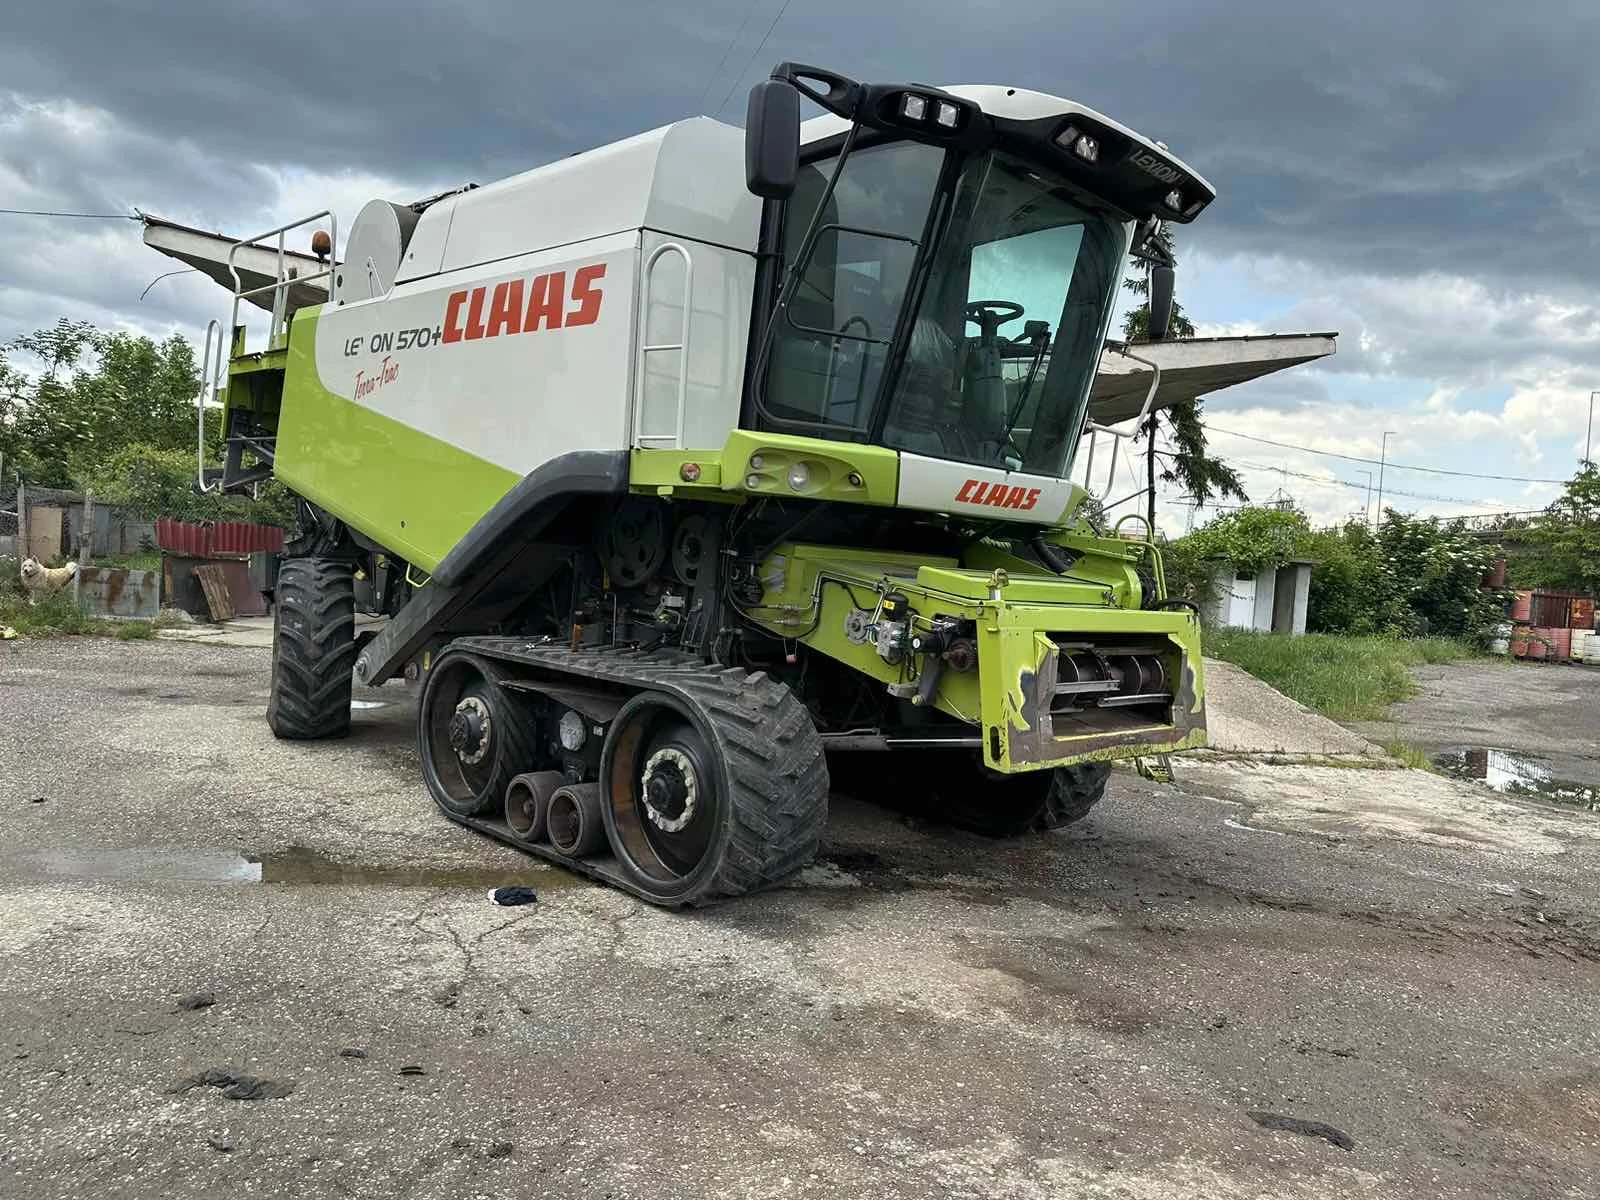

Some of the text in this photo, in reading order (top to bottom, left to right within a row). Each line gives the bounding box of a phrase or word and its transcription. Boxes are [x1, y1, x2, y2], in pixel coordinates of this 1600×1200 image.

[1130, 150, 1182, 183] LEXION
[441, 263, 608, 344] CLAAS
[344, 325, 442, 357] LEON 570+
[955, 479, 1042, 511] CLAAS
